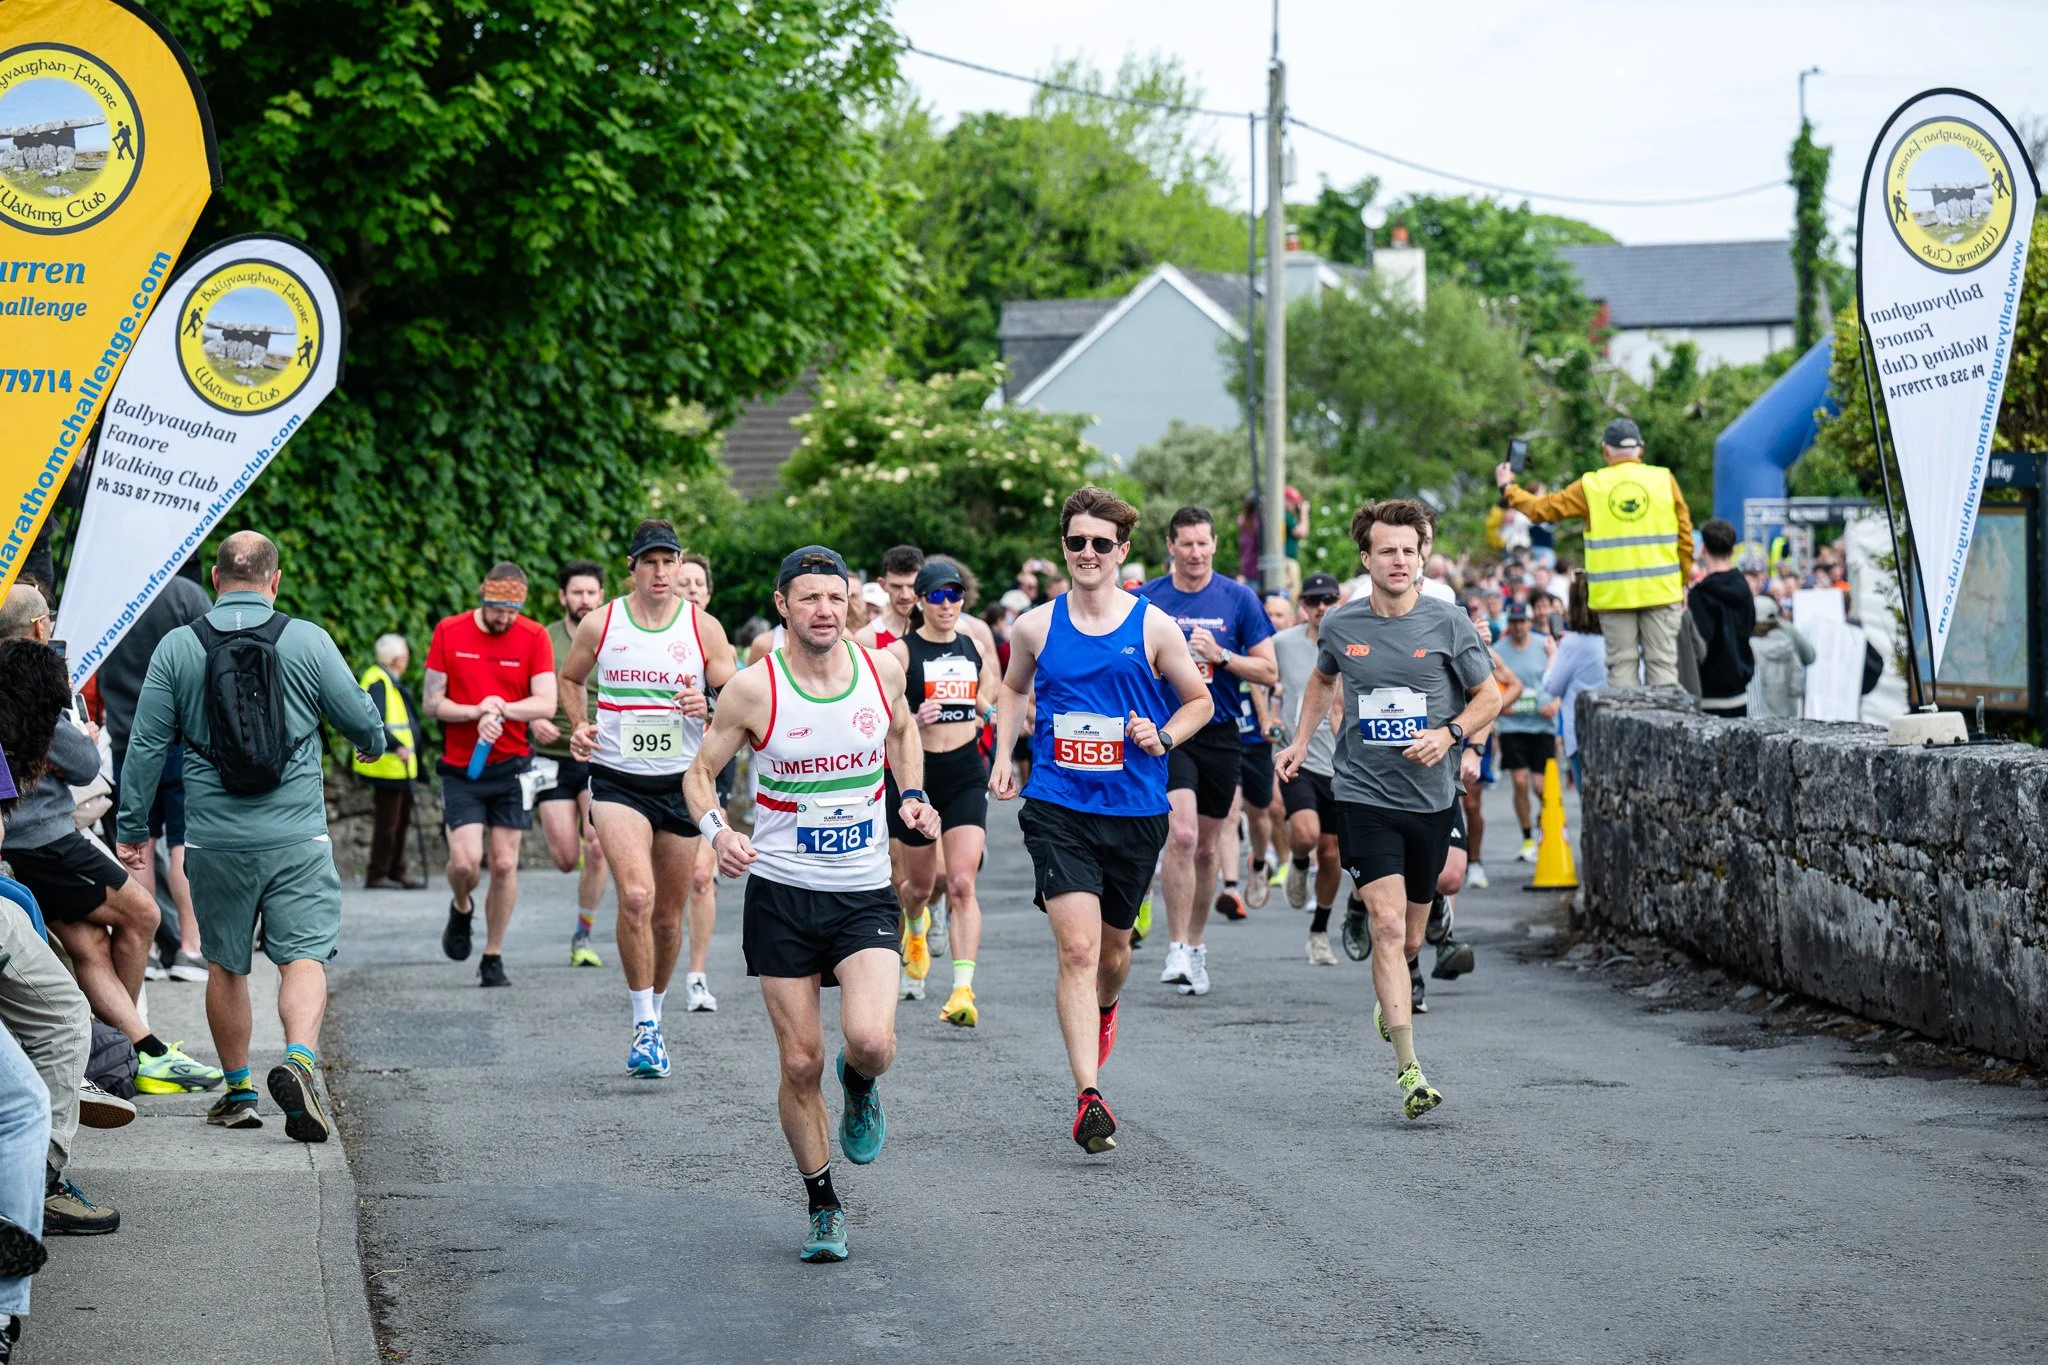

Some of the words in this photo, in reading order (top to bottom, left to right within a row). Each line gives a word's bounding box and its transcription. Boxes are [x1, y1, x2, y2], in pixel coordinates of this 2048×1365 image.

[0, 58, 117, 109] yvaughan-Fanore
[66, 191, 107, 218] Club
[200, 271, 309, 325] Ballyvaughan-Fanore
[195, 366, 243, 408] Walking
[247, 387, 280, 405] Club
[112, 398, 237, 443] Ballyvaughan
[106, 423, 169, 453] Fanore
[101, 450, 174, 486] Walking
[178, 469, 219, 493] Club
[96, 477, 109, 492] Ph
[112, 481, 133, 498] 353
[135, 487, 151, 501] 87
[152, 490, 201, 513] 7779714
[935, 681, 970, 698] 5011
[632, 733, 671, 752] 995
[1367, 719, 1418, 740] 1338
[771, 751, 864, 775] LIMERICK
[1061, 740, 1115, 763] 5158
[810, 825, 861, 852] 1218
